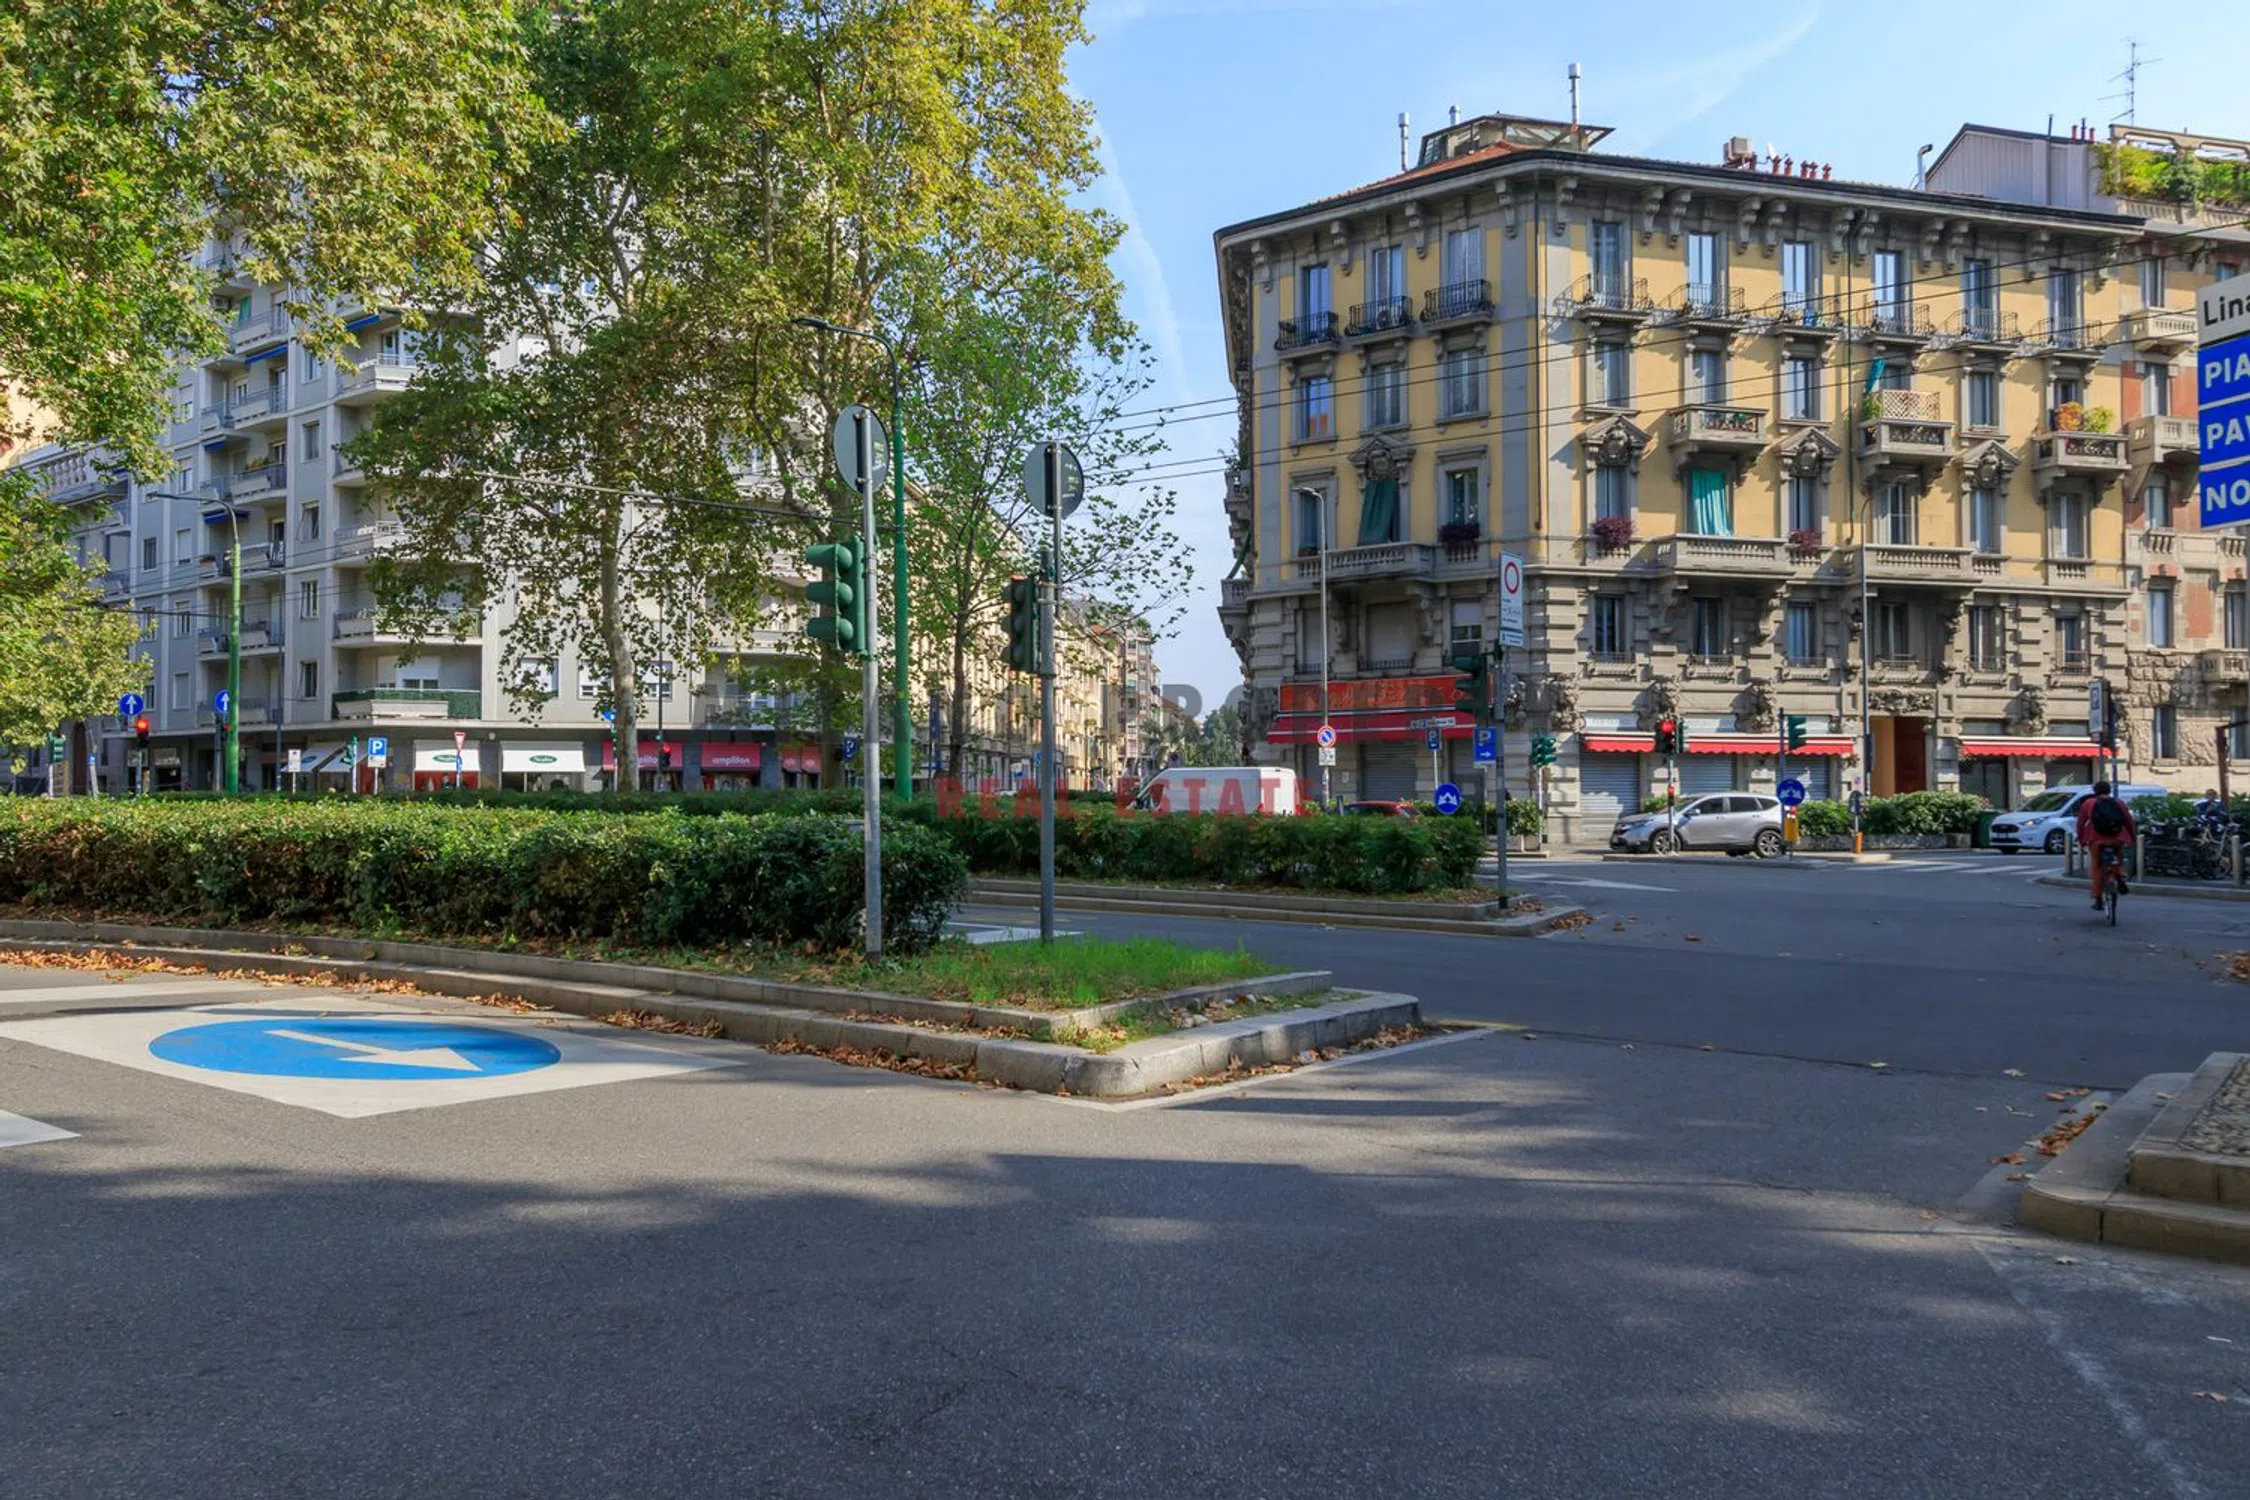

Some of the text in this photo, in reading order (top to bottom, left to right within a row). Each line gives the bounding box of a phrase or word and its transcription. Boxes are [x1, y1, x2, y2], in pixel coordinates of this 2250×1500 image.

[2205, 353, 2250, 388] PIA
[2206, 479, 2250, 511] NO
[372, 741, 382, 753] P
[711, 756, 750, 766] amplifon
